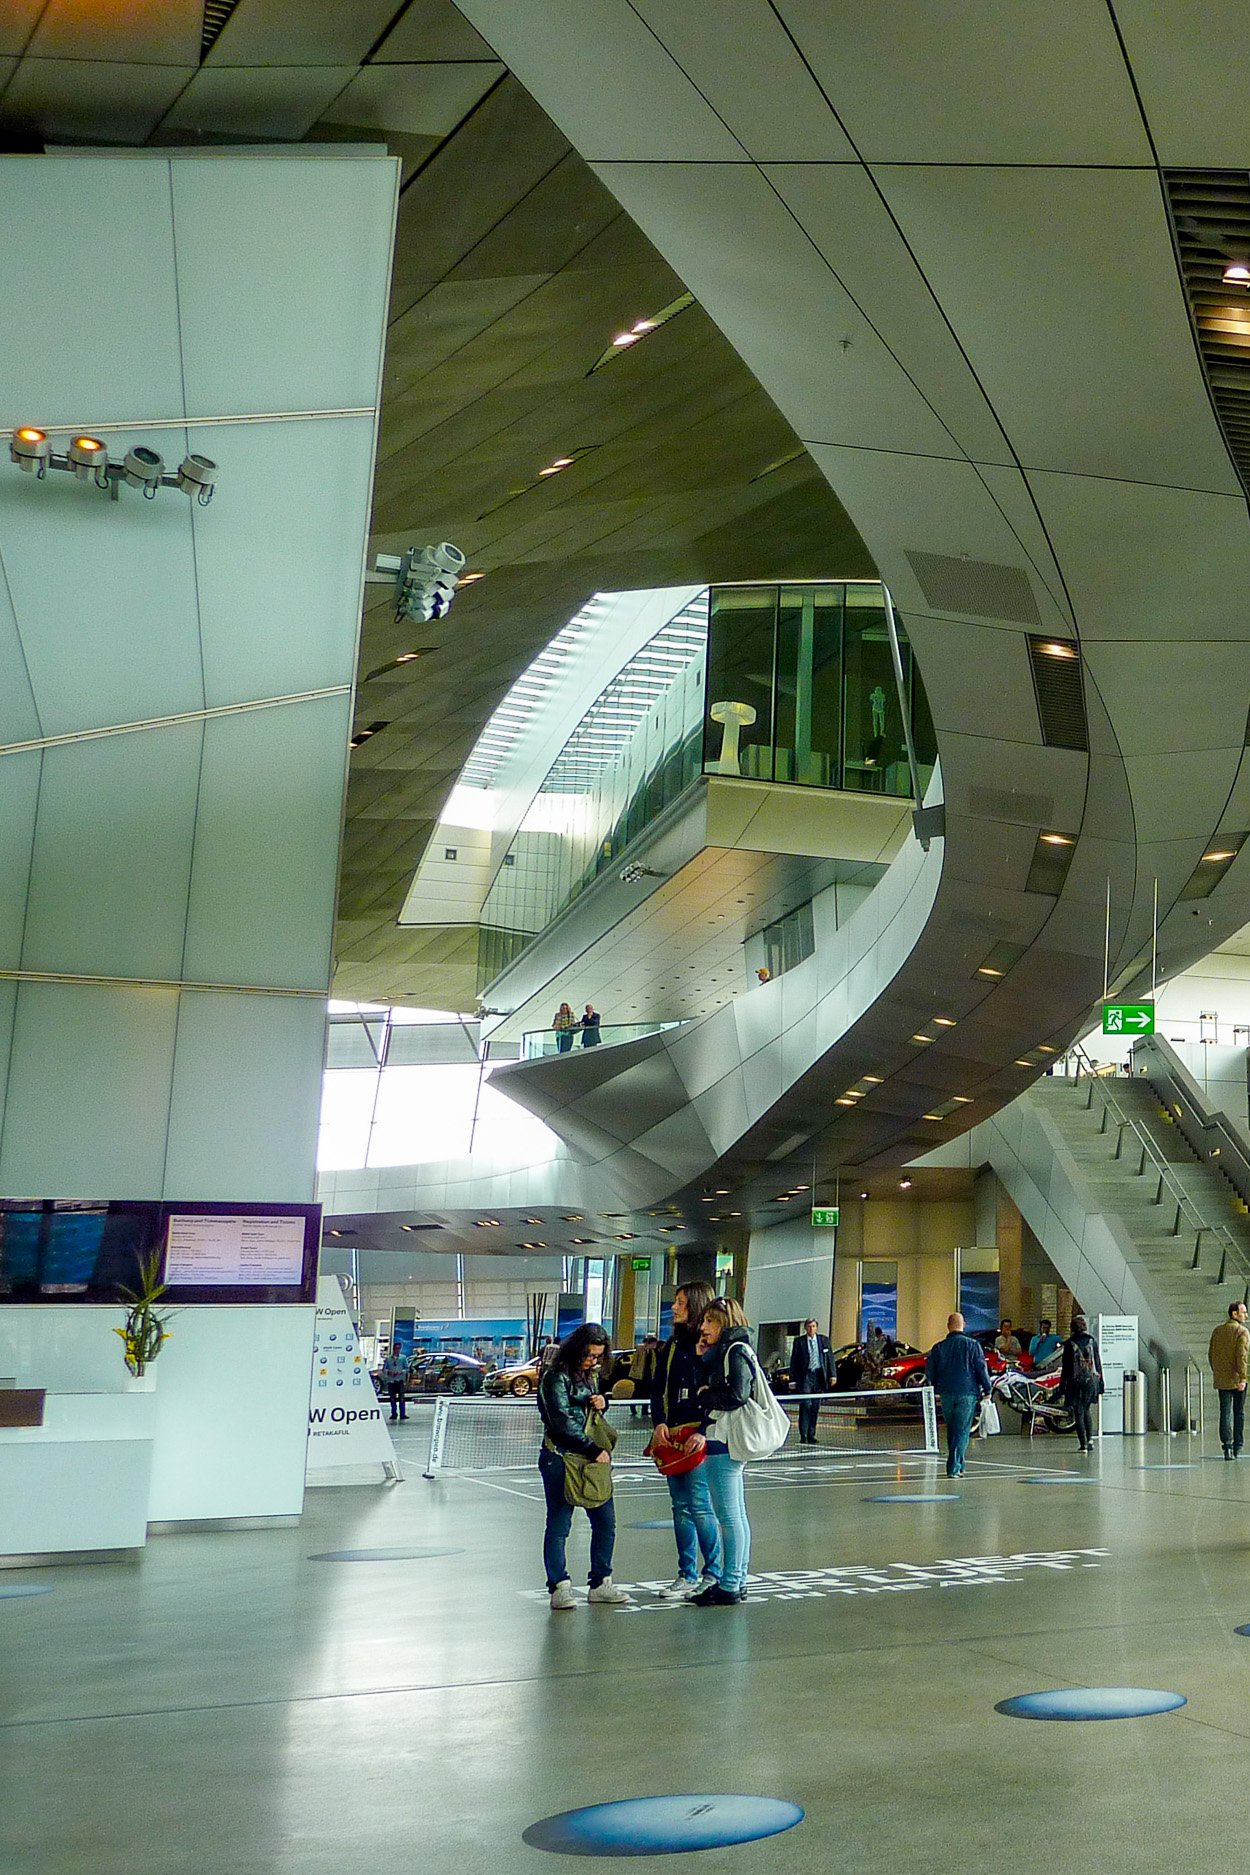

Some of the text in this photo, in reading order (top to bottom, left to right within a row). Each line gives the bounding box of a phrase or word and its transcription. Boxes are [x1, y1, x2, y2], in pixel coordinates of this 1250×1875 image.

[325, 1308, 347, 1316] Open
[330, 1407, 380, 1425] Open
[857, 1560, 1101, 1584] LUFT.
[773, 1591, 827, 1600] IN
[827, 1583, 931, 1595] THE
[939, 1577, 1024, 1588] AIR.
